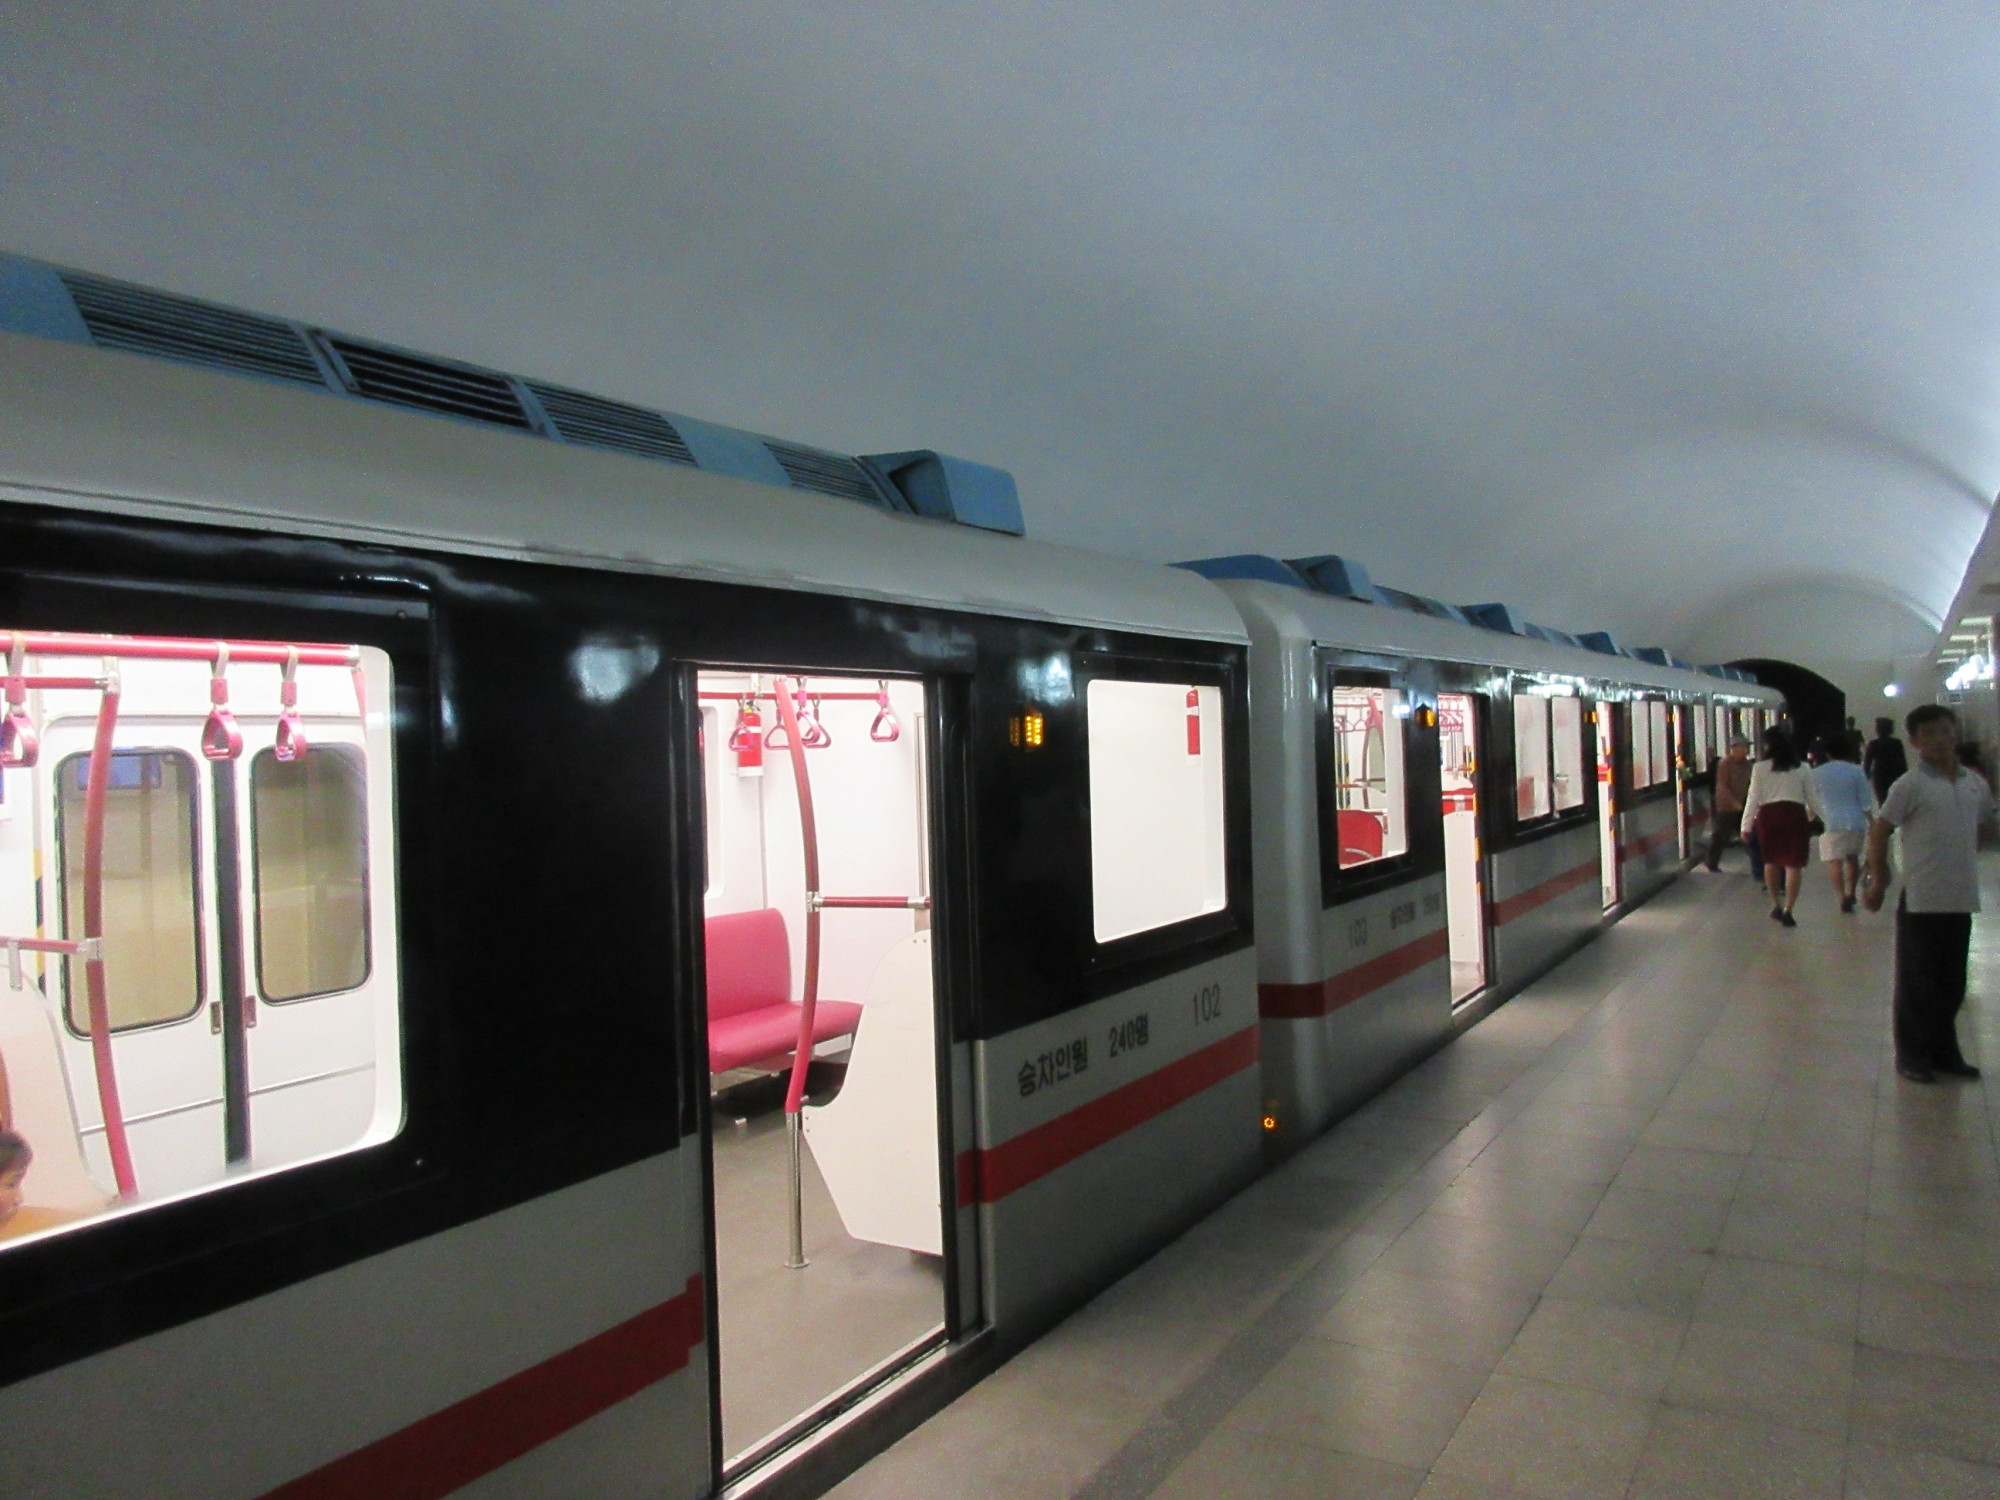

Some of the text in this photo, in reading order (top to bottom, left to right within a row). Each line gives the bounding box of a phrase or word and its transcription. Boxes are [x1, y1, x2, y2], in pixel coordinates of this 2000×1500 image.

[1193, 983, 1222, 1026] 102
[1018, 1012, 1150, 1097] 승차인원 240명
